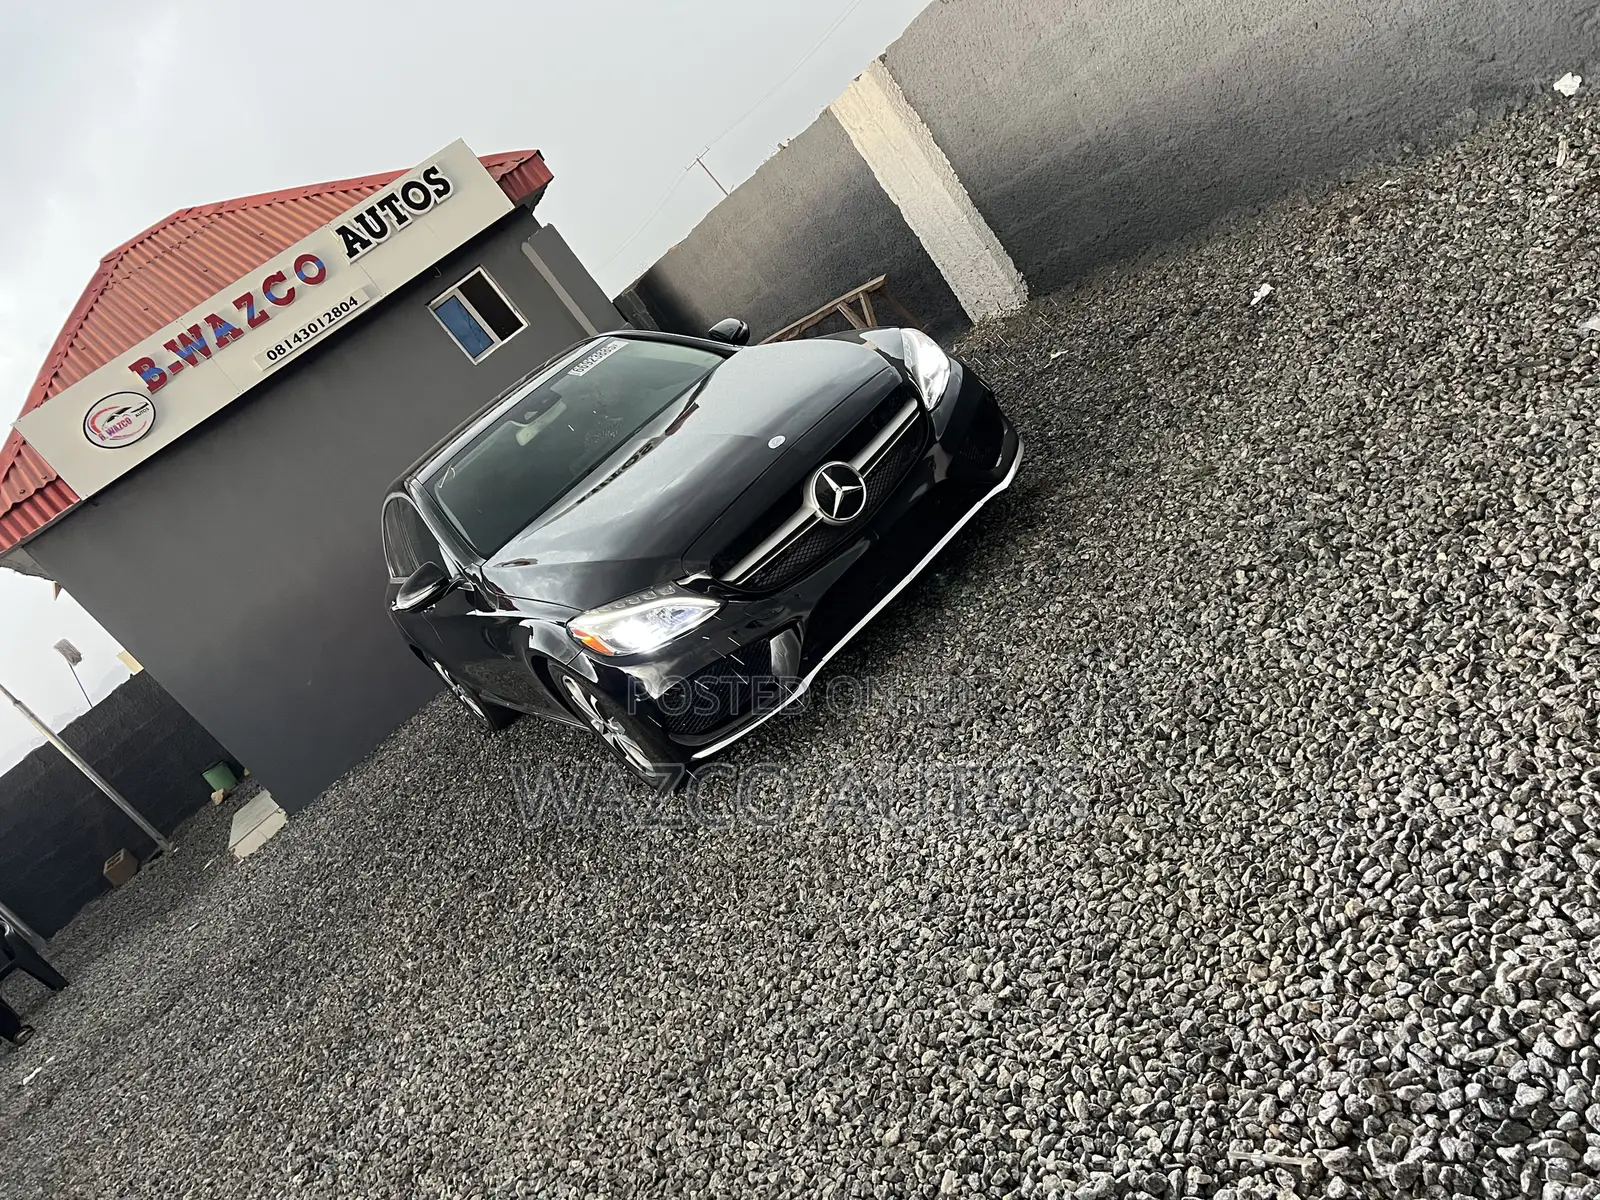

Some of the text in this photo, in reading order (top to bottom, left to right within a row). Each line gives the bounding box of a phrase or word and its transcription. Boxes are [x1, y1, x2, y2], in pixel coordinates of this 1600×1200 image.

[335, 165, 452, 259] AUTOS
[265, 296, 359, 362] 08143012804
[105, 417, 132, 436] WAZCO
